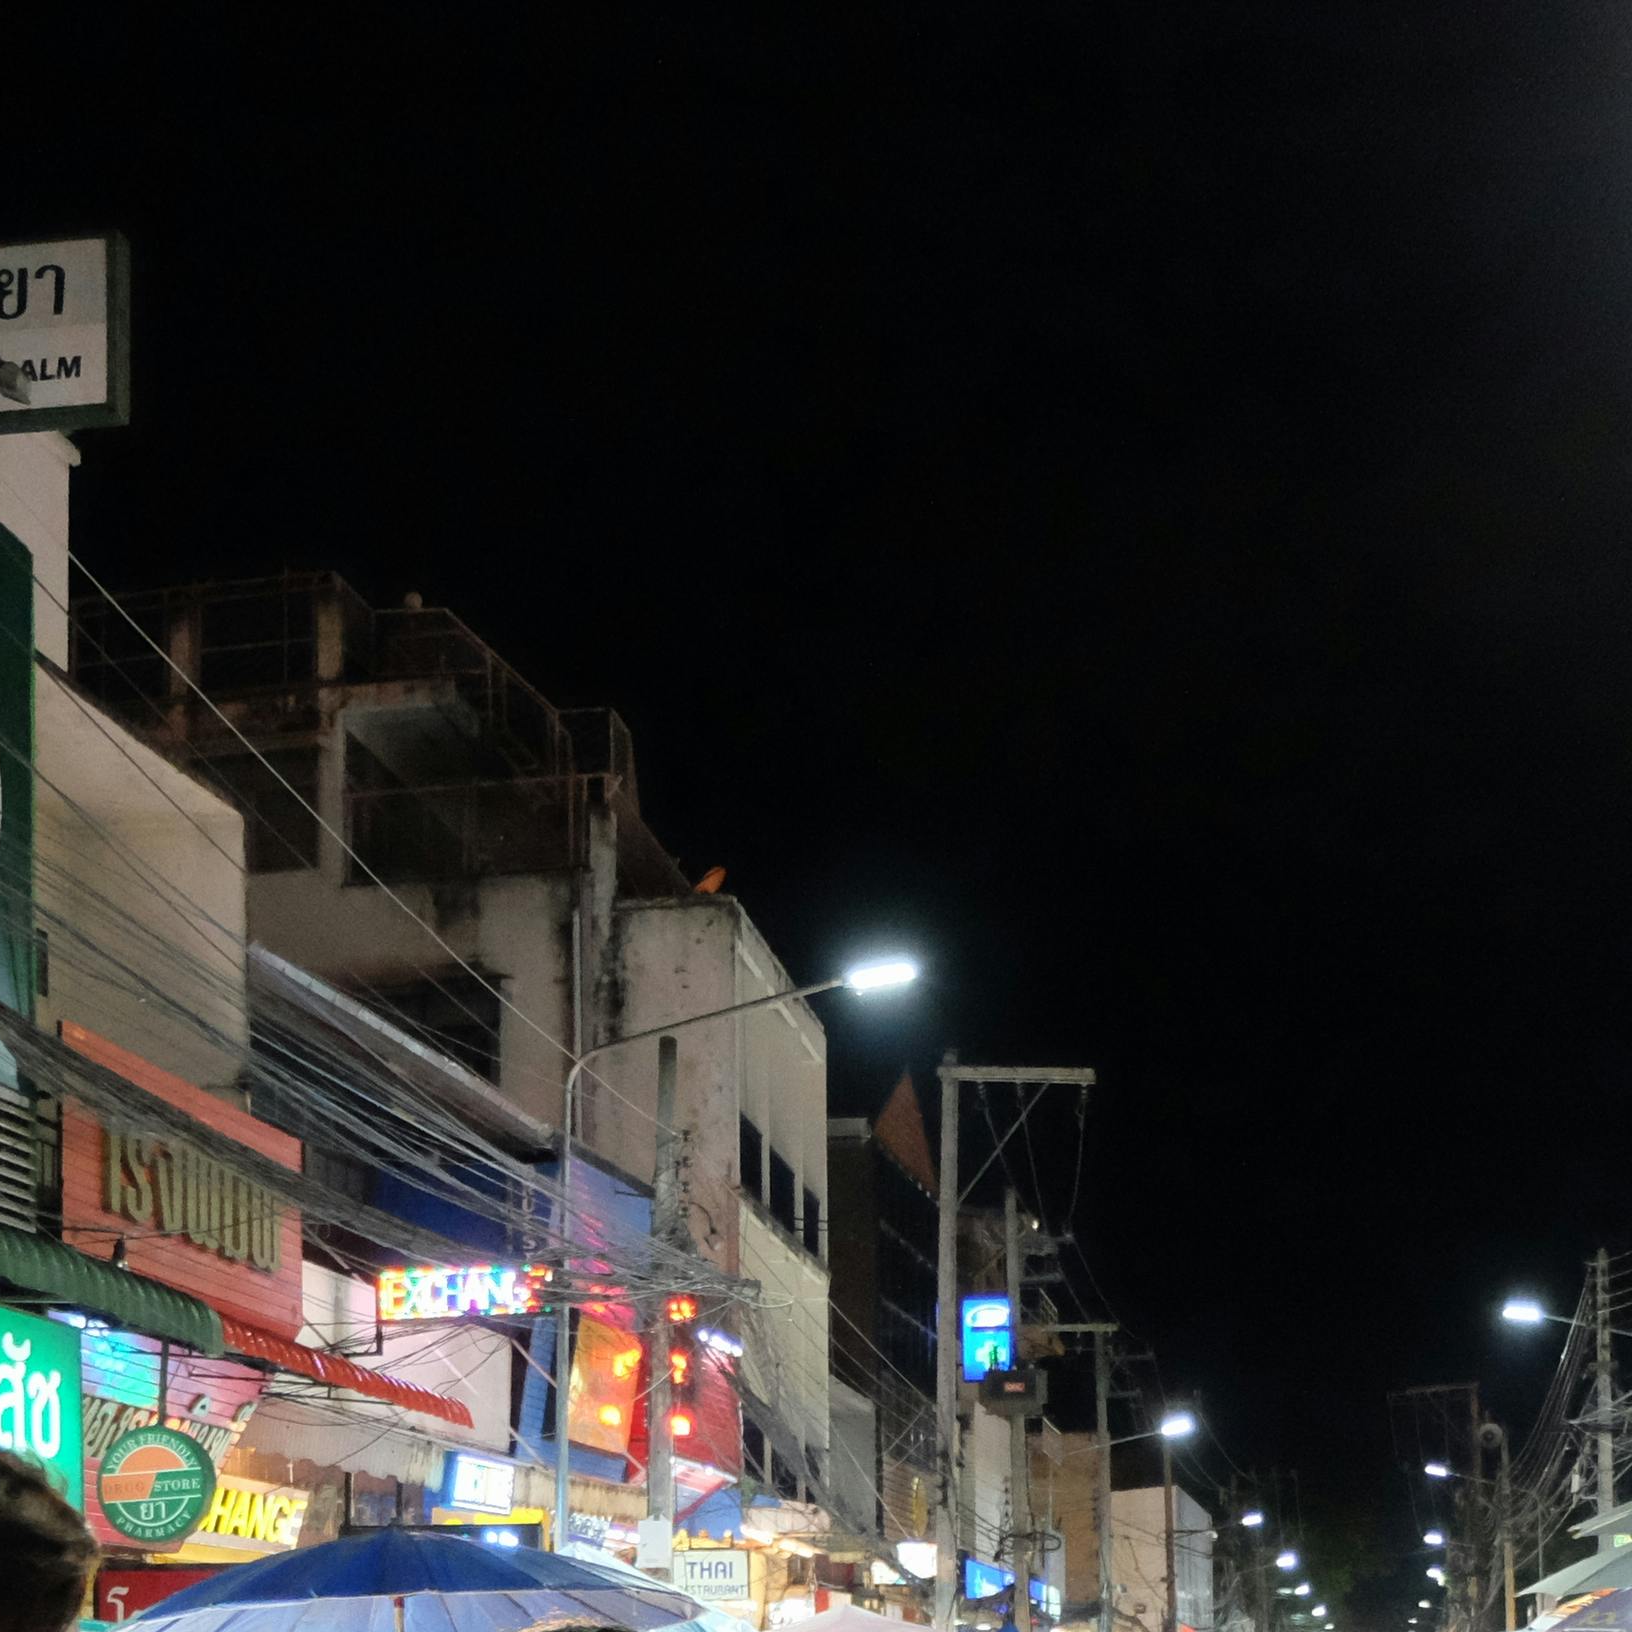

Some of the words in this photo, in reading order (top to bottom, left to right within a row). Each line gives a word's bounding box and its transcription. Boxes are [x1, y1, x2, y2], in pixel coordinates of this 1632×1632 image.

[107, 1438, 137, 1475] YOUR
[138, 1432, 198, 1470] FRIENDLY
[154, 1477, 201, 1491] STORE
[139, 1501, 166, 1520] ยา
[199, 1486, 308, 1549] HANGE
[116, 1509, 193, 1538] PHARMACY
[685, 1561, 734, 1579] THAI
